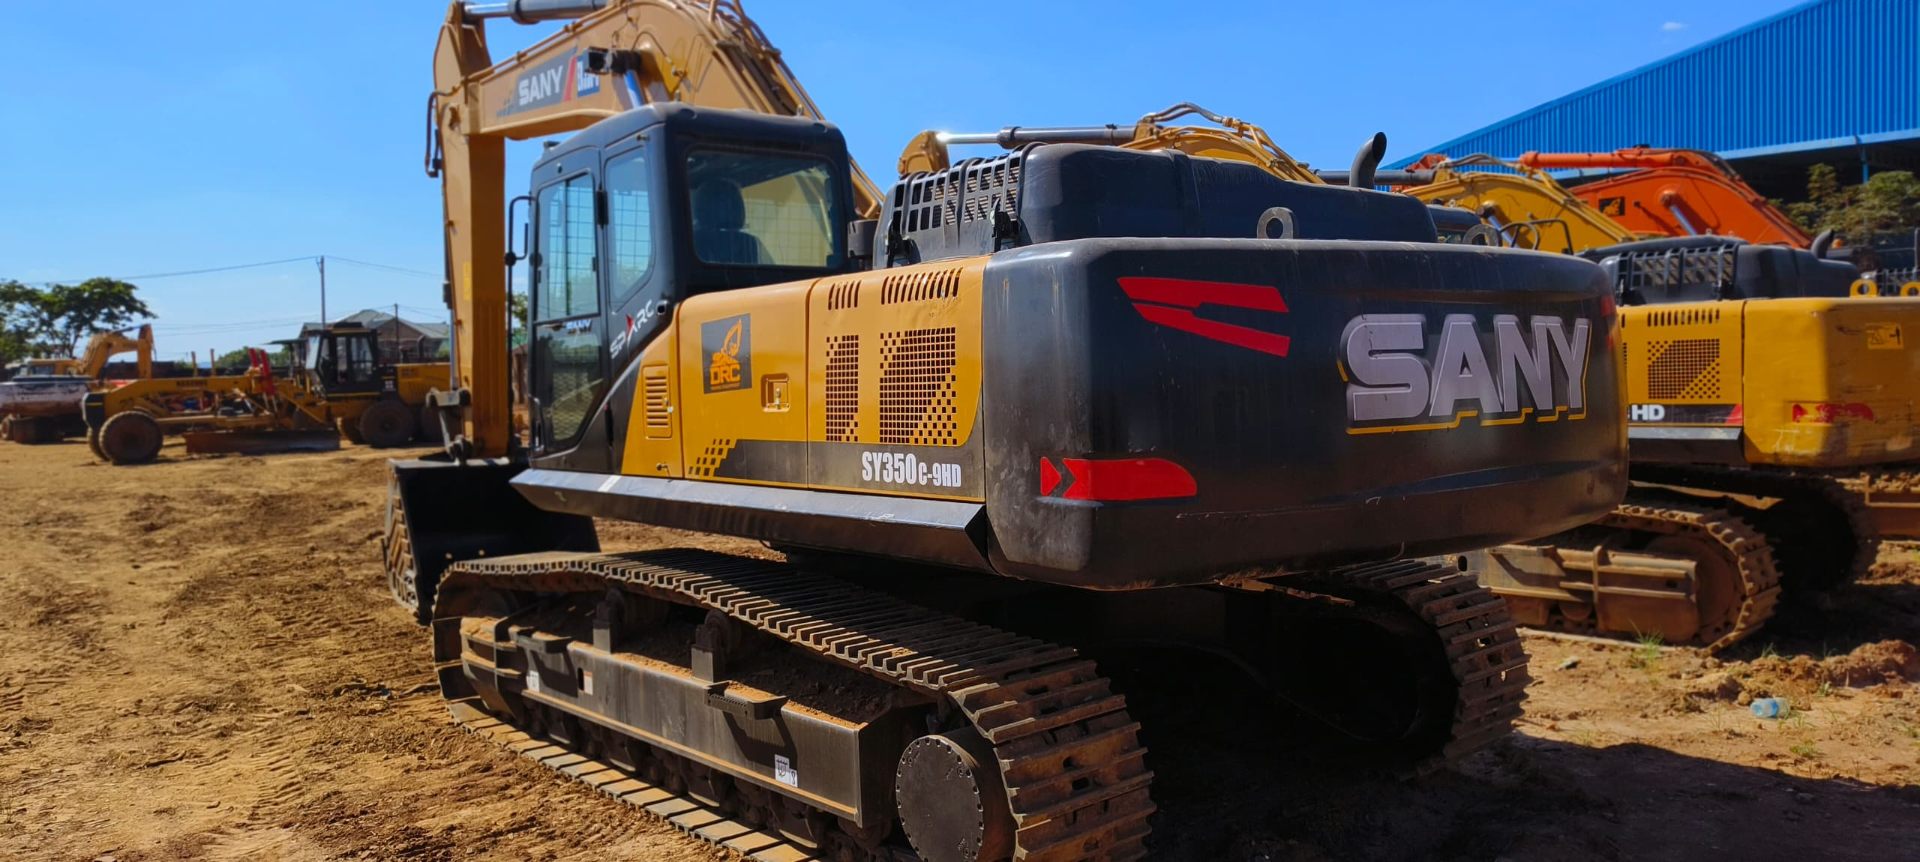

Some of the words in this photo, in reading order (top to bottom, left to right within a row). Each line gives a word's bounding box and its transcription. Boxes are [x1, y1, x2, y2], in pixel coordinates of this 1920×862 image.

[518, 65, 563, 106] SANY
[610, 299, 654, 359] SPARC
[1340, 313, 1590, 424] SANY
[1627, 404, 1665, 420] HD
